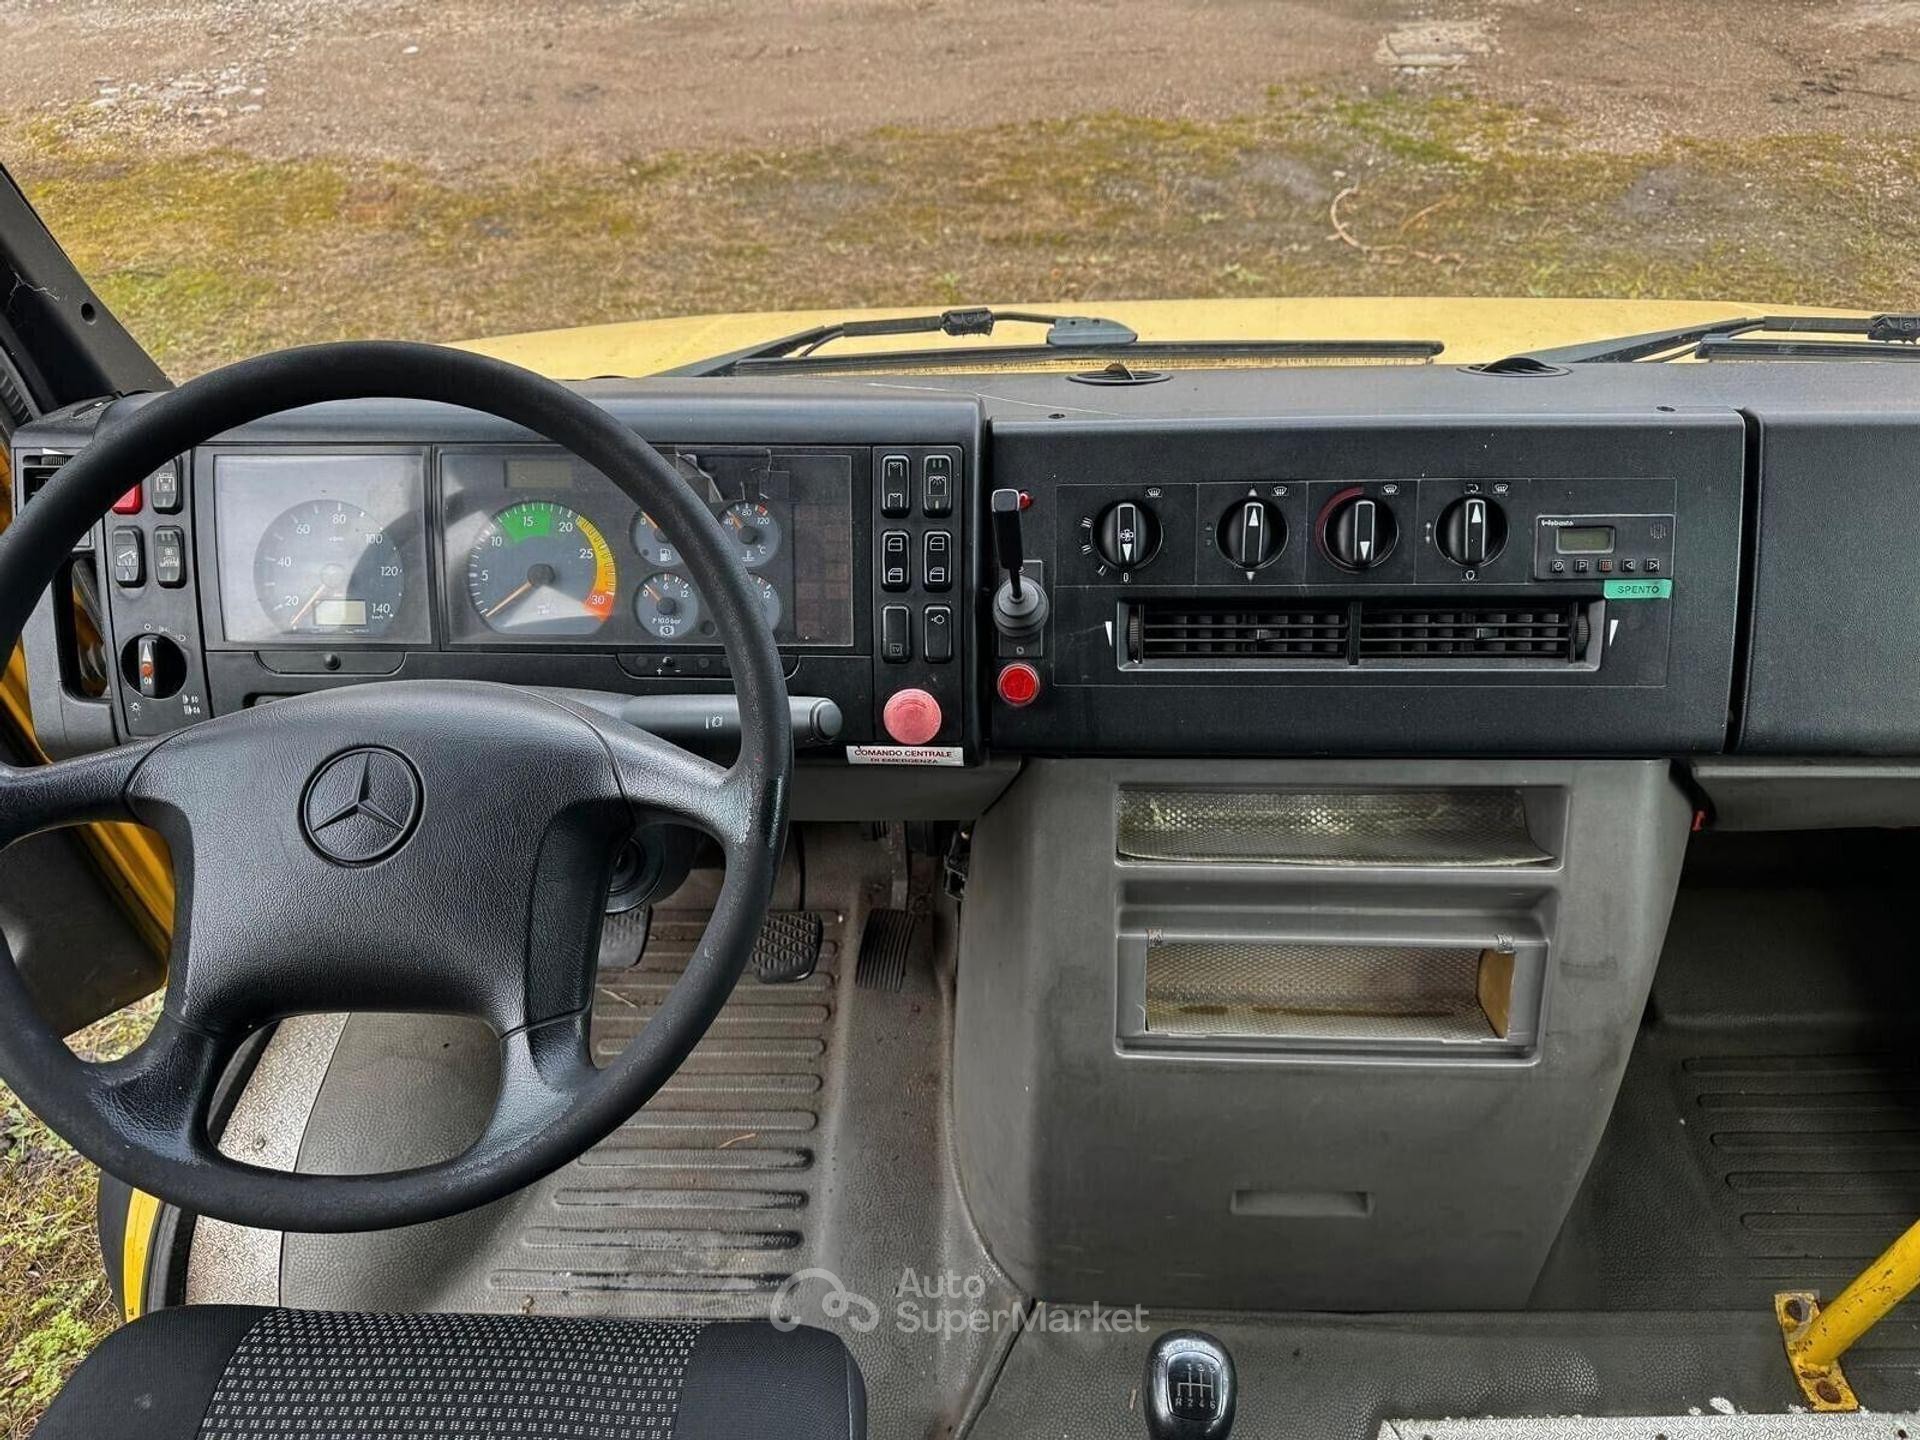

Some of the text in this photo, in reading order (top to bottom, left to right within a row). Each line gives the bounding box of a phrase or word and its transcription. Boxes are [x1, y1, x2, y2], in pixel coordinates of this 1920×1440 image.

[332, 514, 346, 524] 80
[523, 516, 534, 527] 15
[296, 524, 310, 535] 60
[558, 522, 573, 533] 20
[365, 534, 383, 544] 100
[491, 536, 502, 547] 10
[579, 548, 594, 559] 25
[277, 556, 292, 567] 40
[380, 566, 399, 577] 120
[481, 570, 489, 581] 5
[1617, 585, 1660, 594] SPENTO
[285, 596, 299, 606] 20
[592, 594, 605, 604] 30
[372, 603, 391, 614] 140
[854, 749, 902, 757] COMANDO
